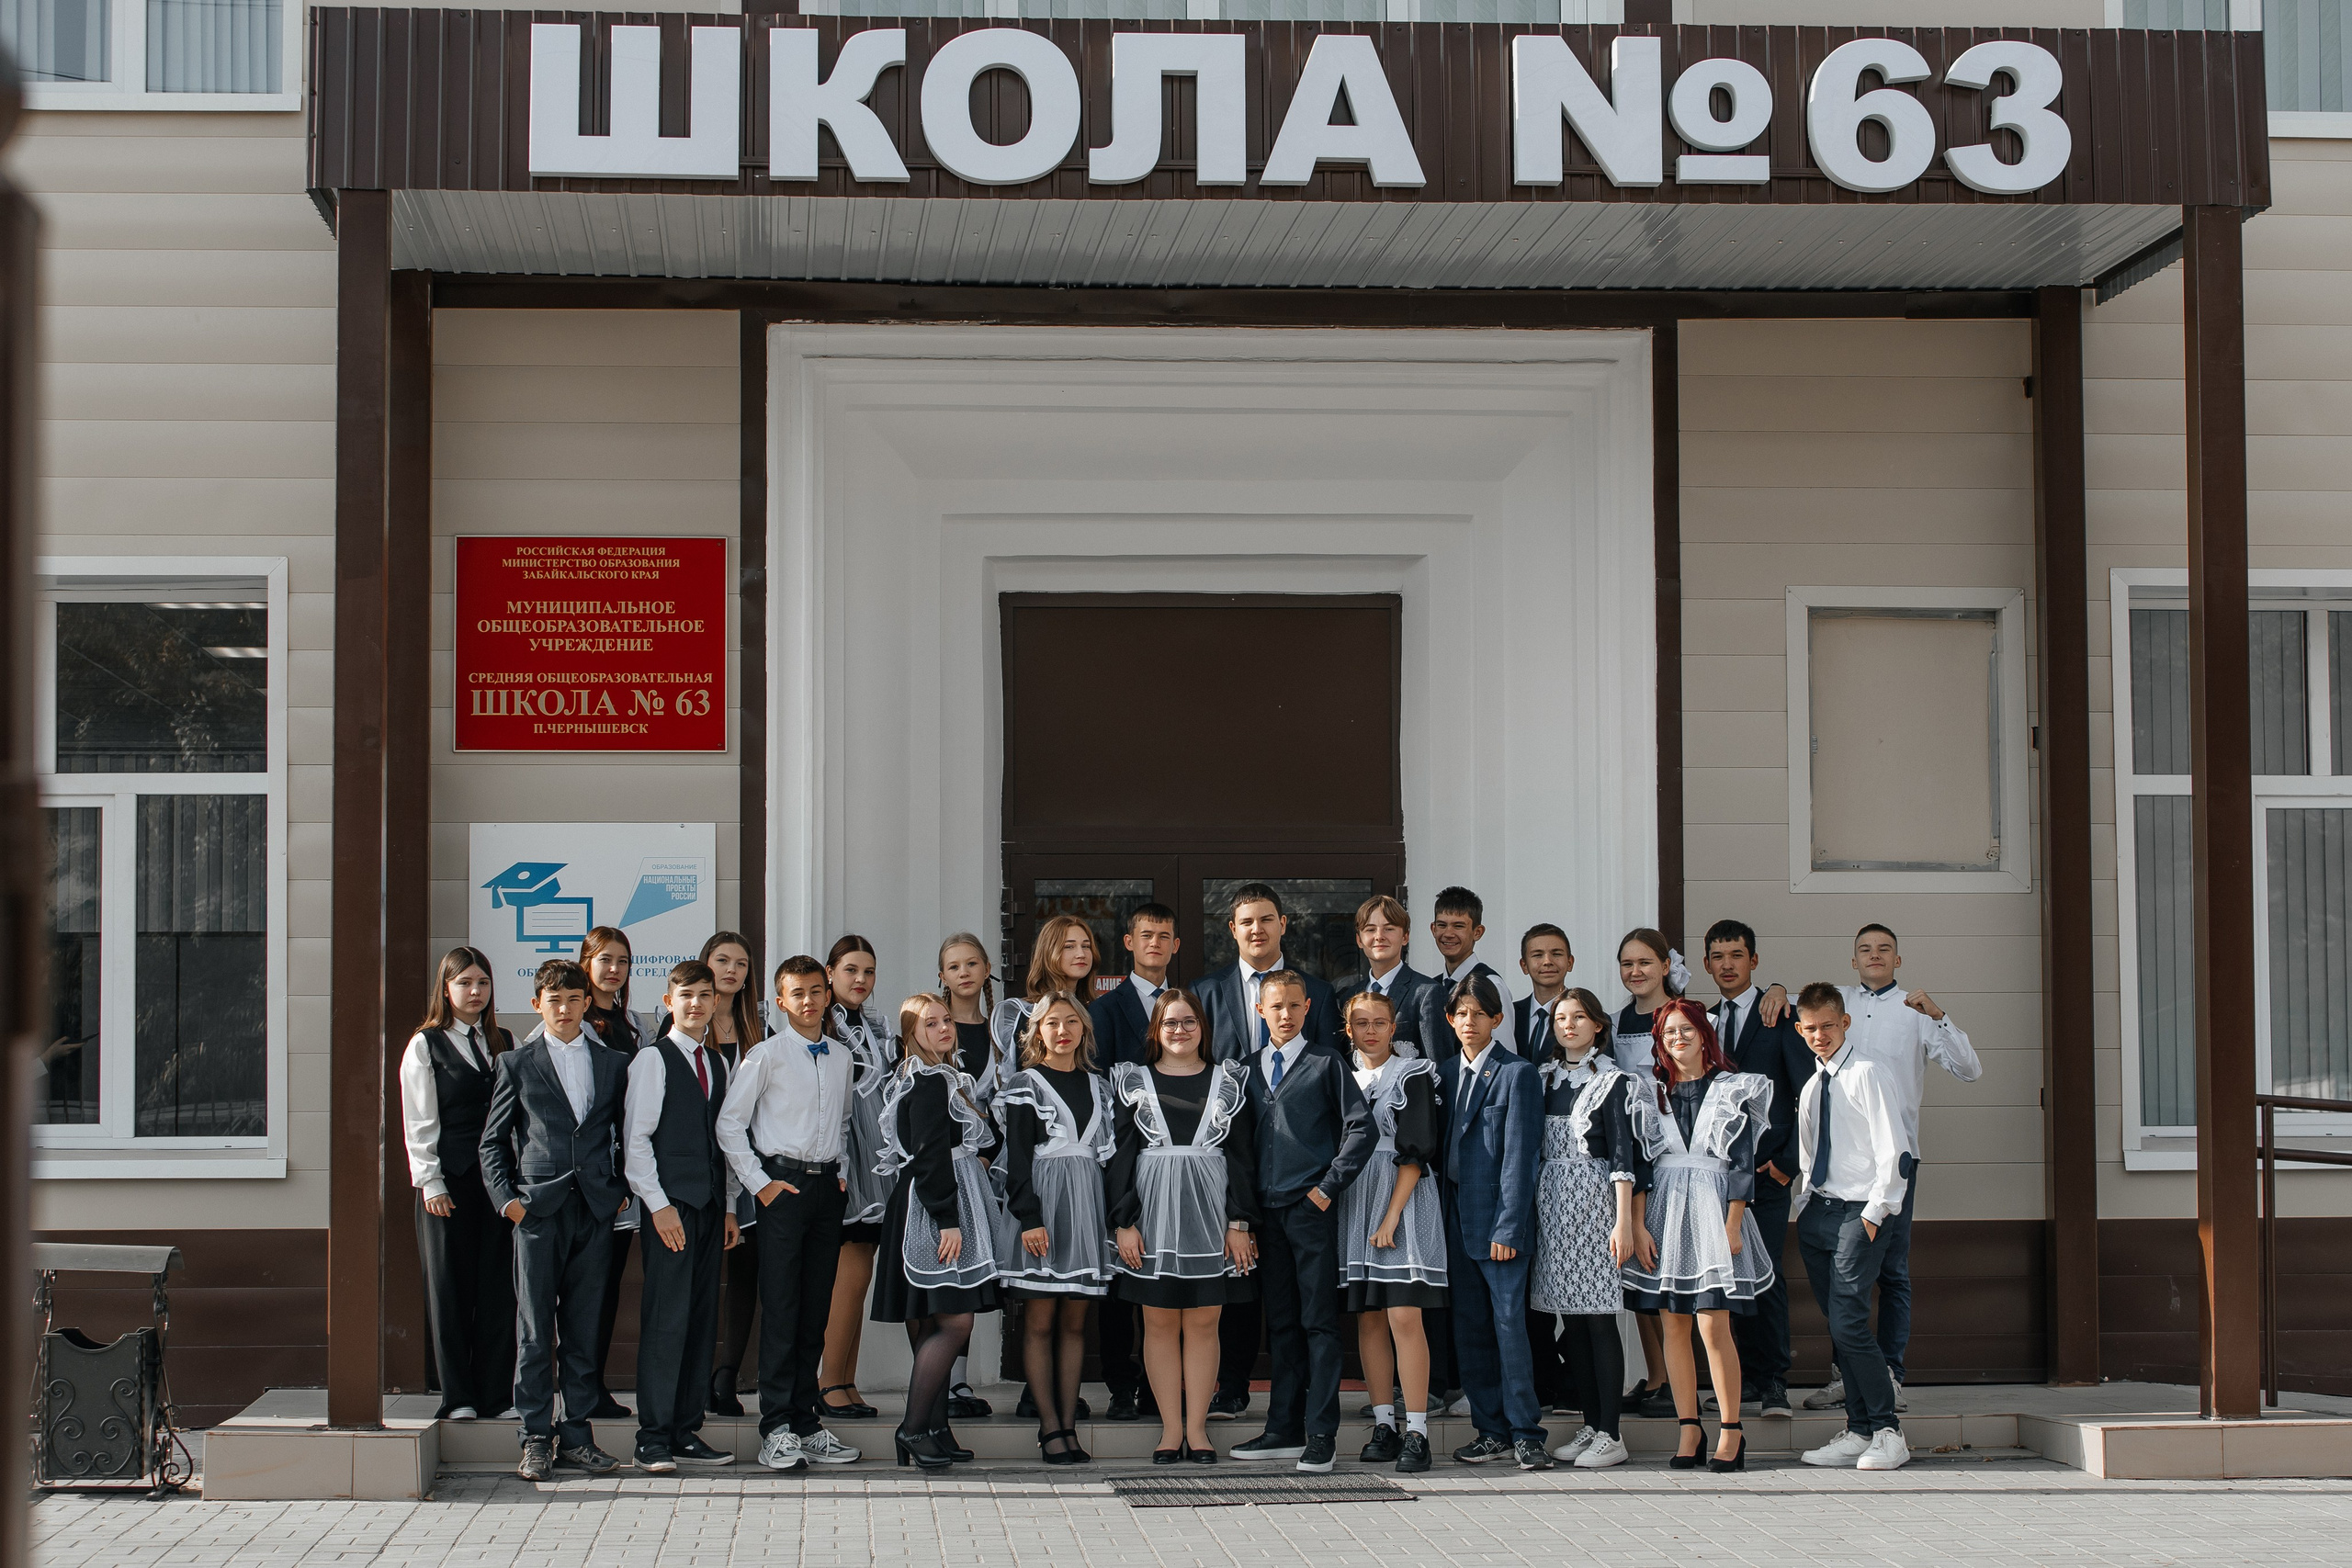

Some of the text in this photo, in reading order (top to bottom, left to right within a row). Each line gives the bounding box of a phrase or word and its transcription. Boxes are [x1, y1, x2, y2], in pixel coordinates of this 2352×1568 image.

[528, 22, 2072, 195] ШКОЛА № 63
[516, 546, 666, 557] РОССИЙСКАЯ ФЕДЕРАЦИЯ
[502, 558, 681, 568] МИНИСТЕРСТВО ОБРАЗОВАНИЯ
[522, 569, 660, 580] ЗАБАЙКАЛЬСКОГО КРАЯ
[506, 601, 676, 616] МУНИЦИПАЛЬНОЕ
[477, 619, 705, 635] ОБЩЕОБРАЗОВАТЕЛЬНОЕ
[529, 638, 654, 653] УЧРЕЖДЕНИЕ
[468, 672, 713, 684] СРЕДНЯЯ ОБЩЕОБРАЗОВАТЕЛЬНАЯ
[470, 689, 711, 716] ШКОЛА № 63
[533, 723, 649, 734] П.ЧЕРНЫШЕВСК
[643, 875, 696, 885] НАЦИОНАЛЬНЫЕ
[666, 884, 696, 892] ПРОЕКТЫ
[671, 892, 696, 900] РОССИИ
